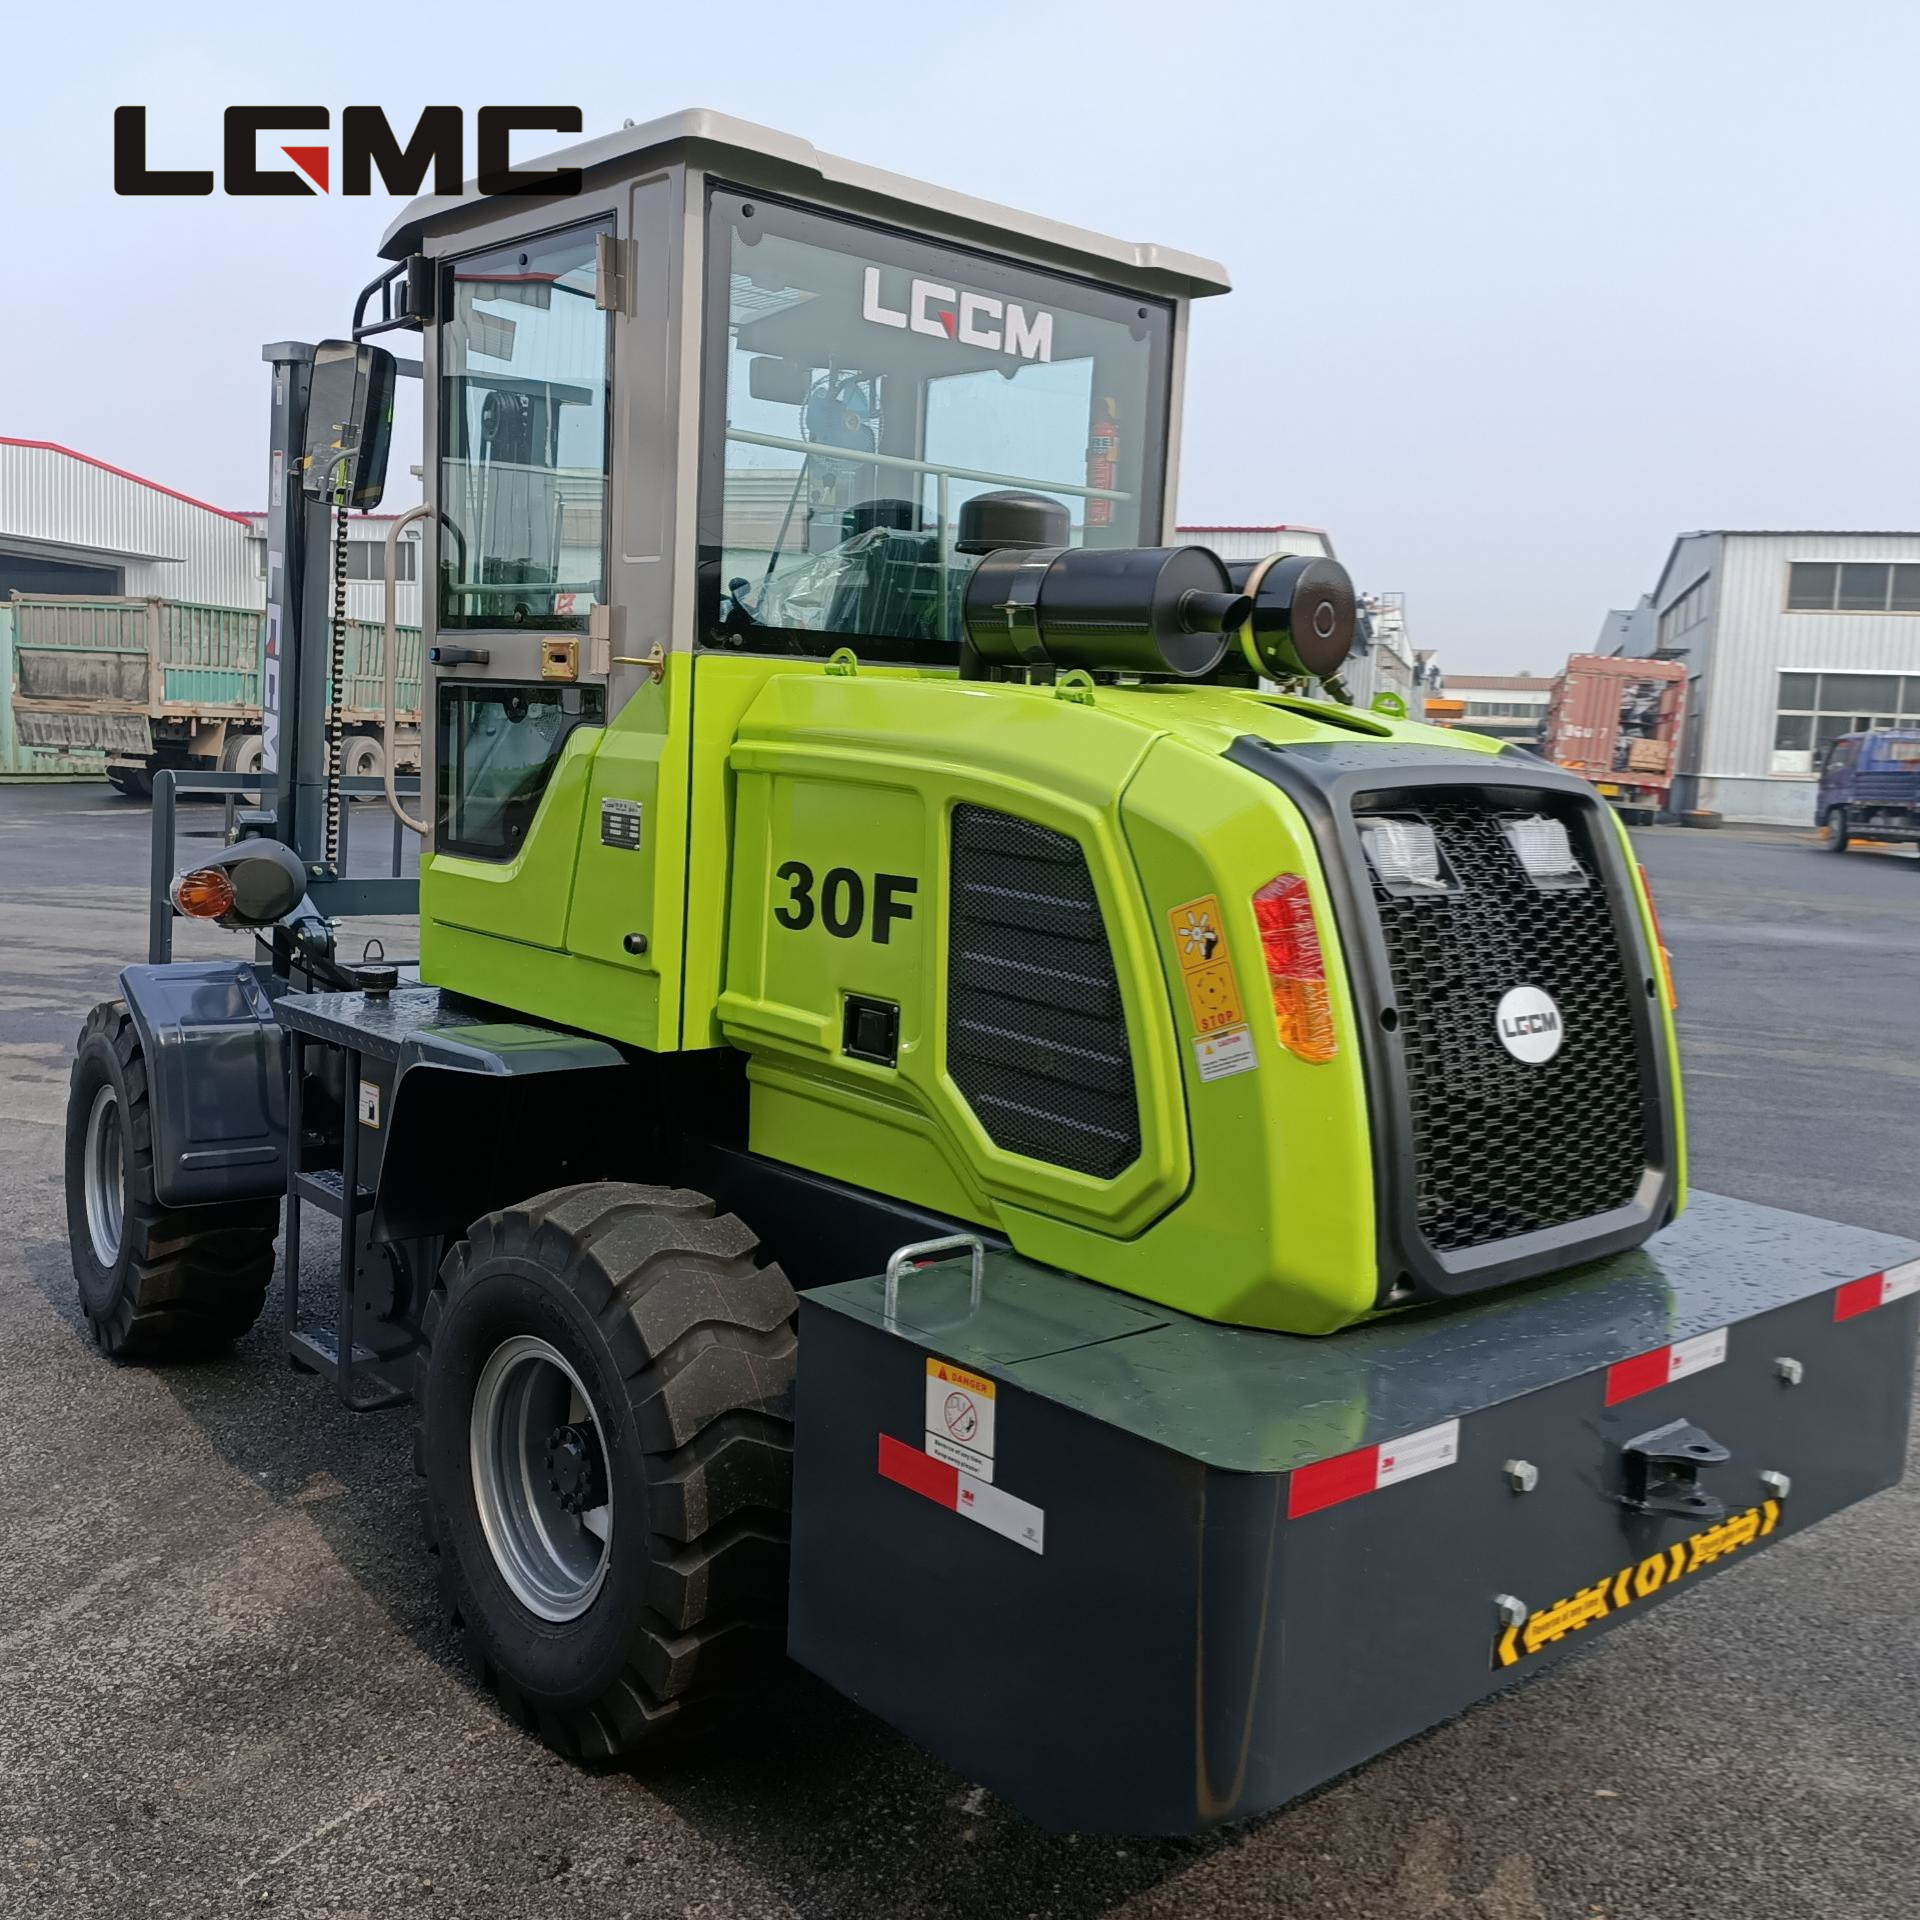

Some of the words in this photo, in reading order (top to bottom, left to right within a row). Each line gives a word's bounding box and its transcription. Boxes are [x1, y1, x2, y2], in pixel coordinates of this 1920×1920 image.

[863, 266, 1053, 363] LGCM
[774, 861, 918, 944] 30F
[1202, 1010, 1233, 1029] STOP
[951, 1372, 987, 1393] DANGER
[961, 1489, 975, 1502] 3M
